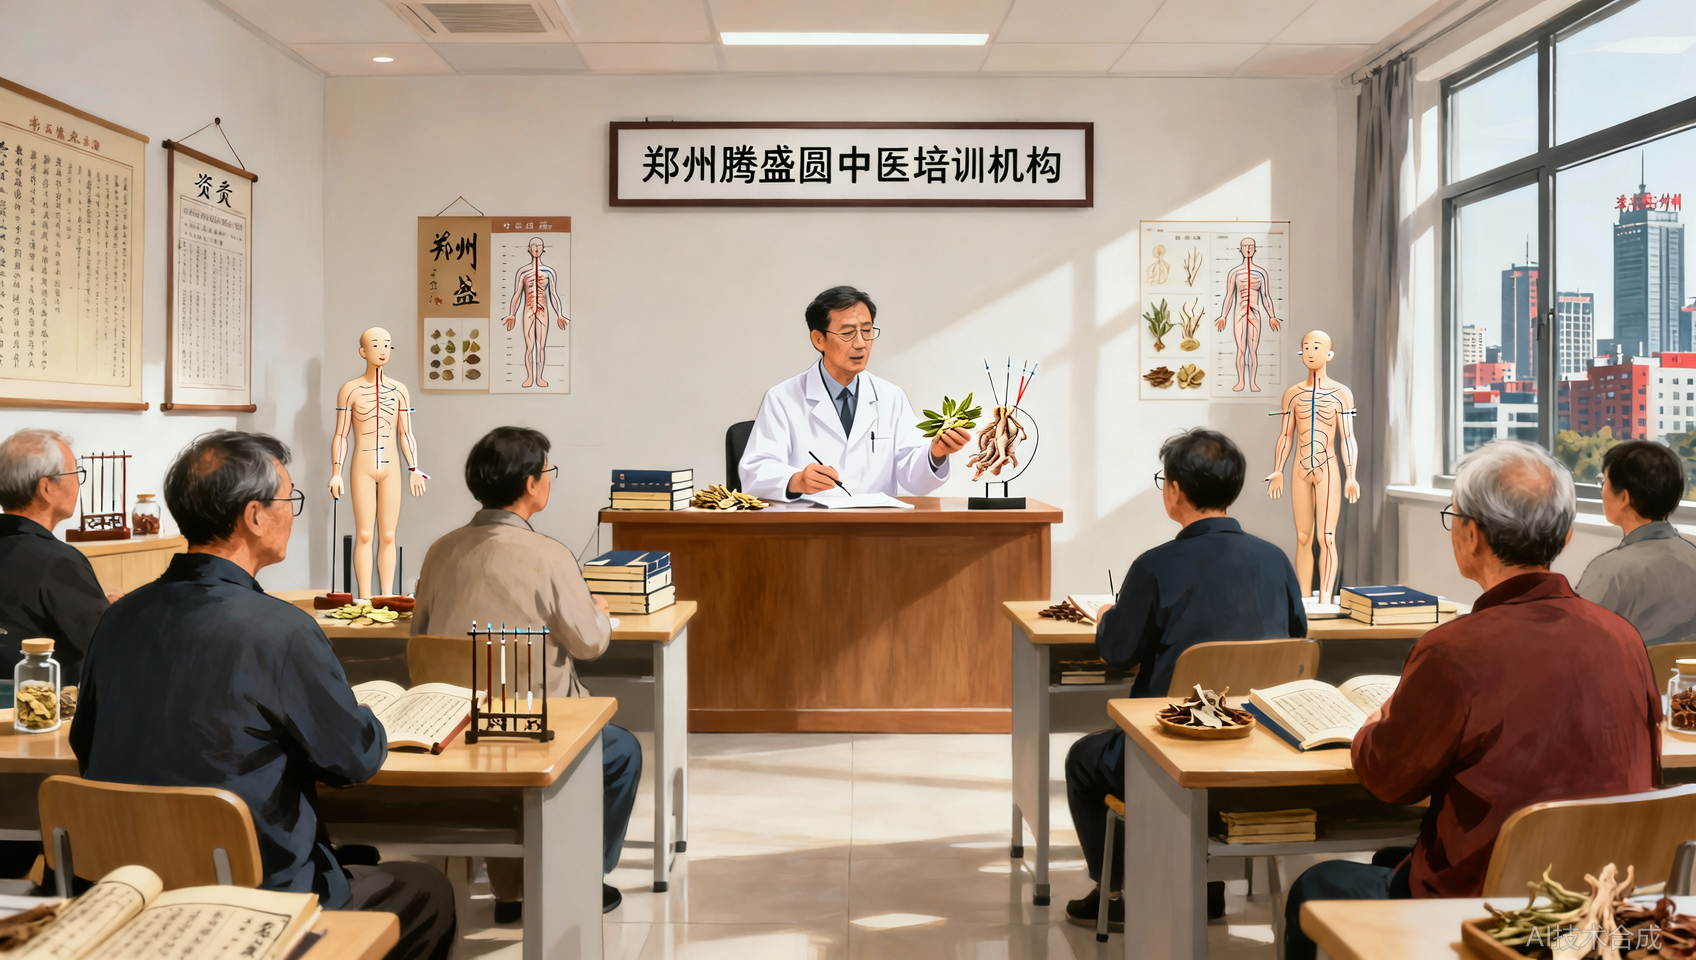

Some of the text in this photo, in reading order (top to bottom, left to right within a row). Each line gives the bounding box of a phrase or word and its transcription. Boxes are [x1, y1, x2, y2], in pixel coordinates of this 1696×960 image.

[642, 144, 1062, 185] 郑州腾盛圆中医培训机构
